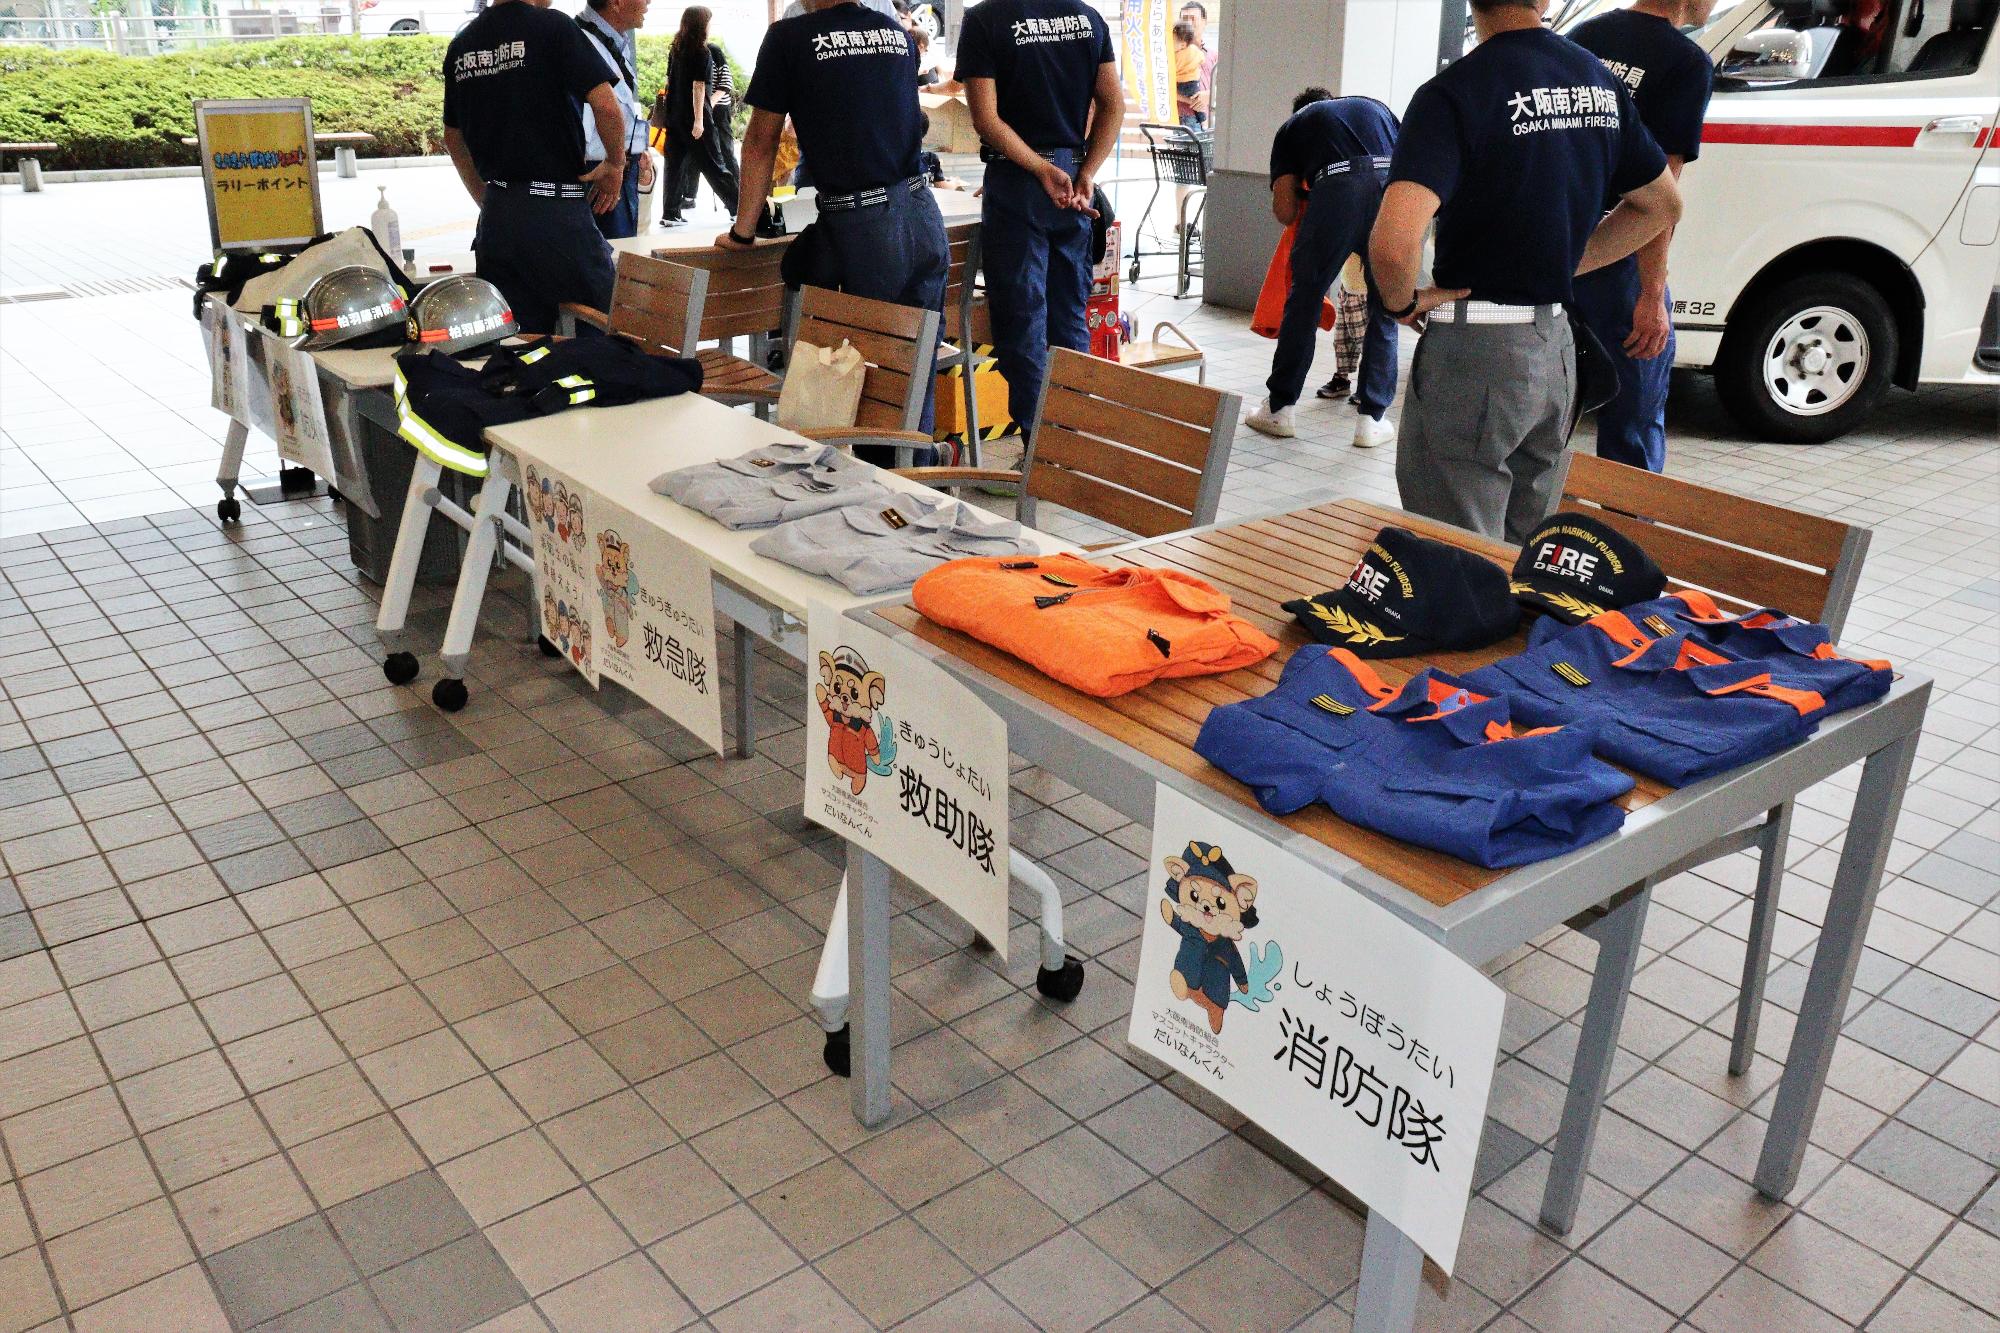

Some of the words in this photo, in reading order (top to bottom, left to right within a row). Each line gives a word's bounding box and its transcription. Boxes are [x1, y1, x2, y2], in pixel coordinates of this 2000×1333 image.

[812, 28, 908, 52] 大阪南消防局
[1011, 15, 1092, 37] 大阪南消防局
[1016, 35, 1038, 46] OSAKA
[1061, 32, 1076, 41] FIRE
[1077, 31, 1095, 39] DEPT.
[816, 48, 847, 60] OSAKA
[848, 46, 877, 56] MINAMI
[877, 45, 894, 54] FIRE
[1152, 0, 1167, 116] らあなたを守る
[1507, 85, 1619, 122] 大阪南消防局
[1513, 119, 1551, 136] OSAKA
[1551, 117, 1583, 130] MINAMI
[1584, 115, 1607, 128] FIRE
[1606, 117, 1620, 130] DEP
[1561, 525, 1598, 544] HABIKINO
[1533, 561, 1592, 585] DEPT.
[1537, 542, 1599, 577] FIRE
[1349, 580, 1380, 605] EPT.
[640, 587, 704, 638] きゅうきゅうたい
[1384, 607, 1401, 620] OSAKA
[643, 621, 709, 695] 救急隊
[899, 720, 991, 801] きゅうじょたい
[824, 803, 873, 838] だいなんくん
[899, 765, 996, 877] 救助隊
[1152, 1010, 1235, 1069] マスコットキャラクター
[1166, 1008, 1219, 1047] 大阪南消防組合
[1294, 961, 1455, 1088] しょうぼうたい
[1153, 1028, 1224, 1080] だいなんくん
[1273, 1008, 1447, 1172] 消防隊
